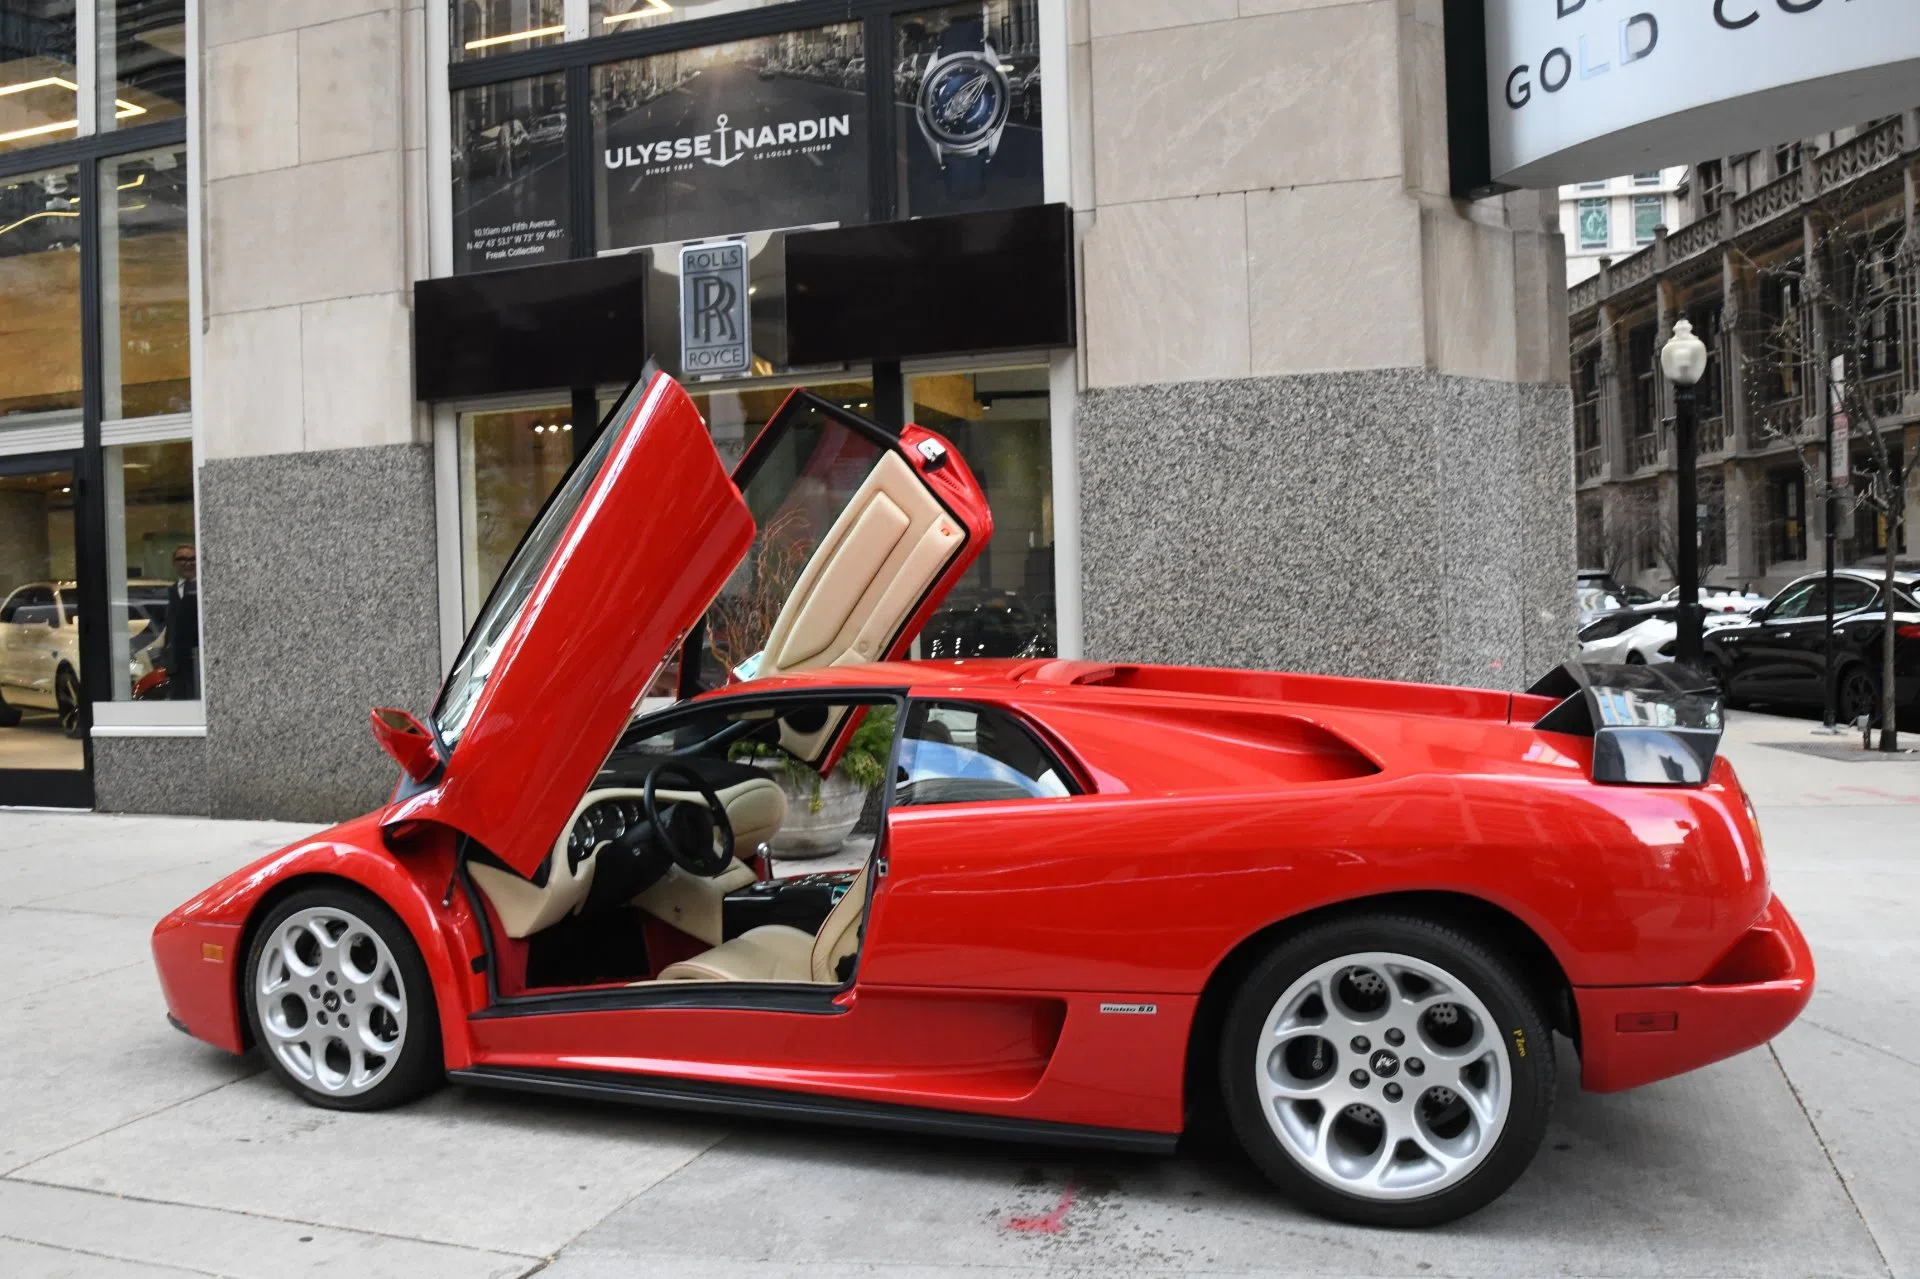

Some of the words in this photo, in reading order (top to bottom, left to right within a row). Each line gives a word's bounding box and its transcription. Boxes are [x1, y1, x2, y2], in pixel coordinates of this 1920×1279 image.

[1505, 12, 1659, 110] GOLD
[604, 134, 712, 169] ULYSSE
[734, 114, 850, 151] NARDIN
[753, 152, 764, 161] LE
[801, 143, 832, 155] SUISSE
[645, 165, 671, 176] SINCE
[501, 225, 512, 234] on
[512, 221, 529, 232] Fifth
[466, 242, 473, 250] N
[514, 234, 523, 244] W
[485, 249, 507, 260] Freak
[507, 245, 545, 257] Collection
[687, 249, 739, 269] ROLLS
[689, 347, 741, 367] ROYCE
[1515, 1037, 1527, 1057] Zero
